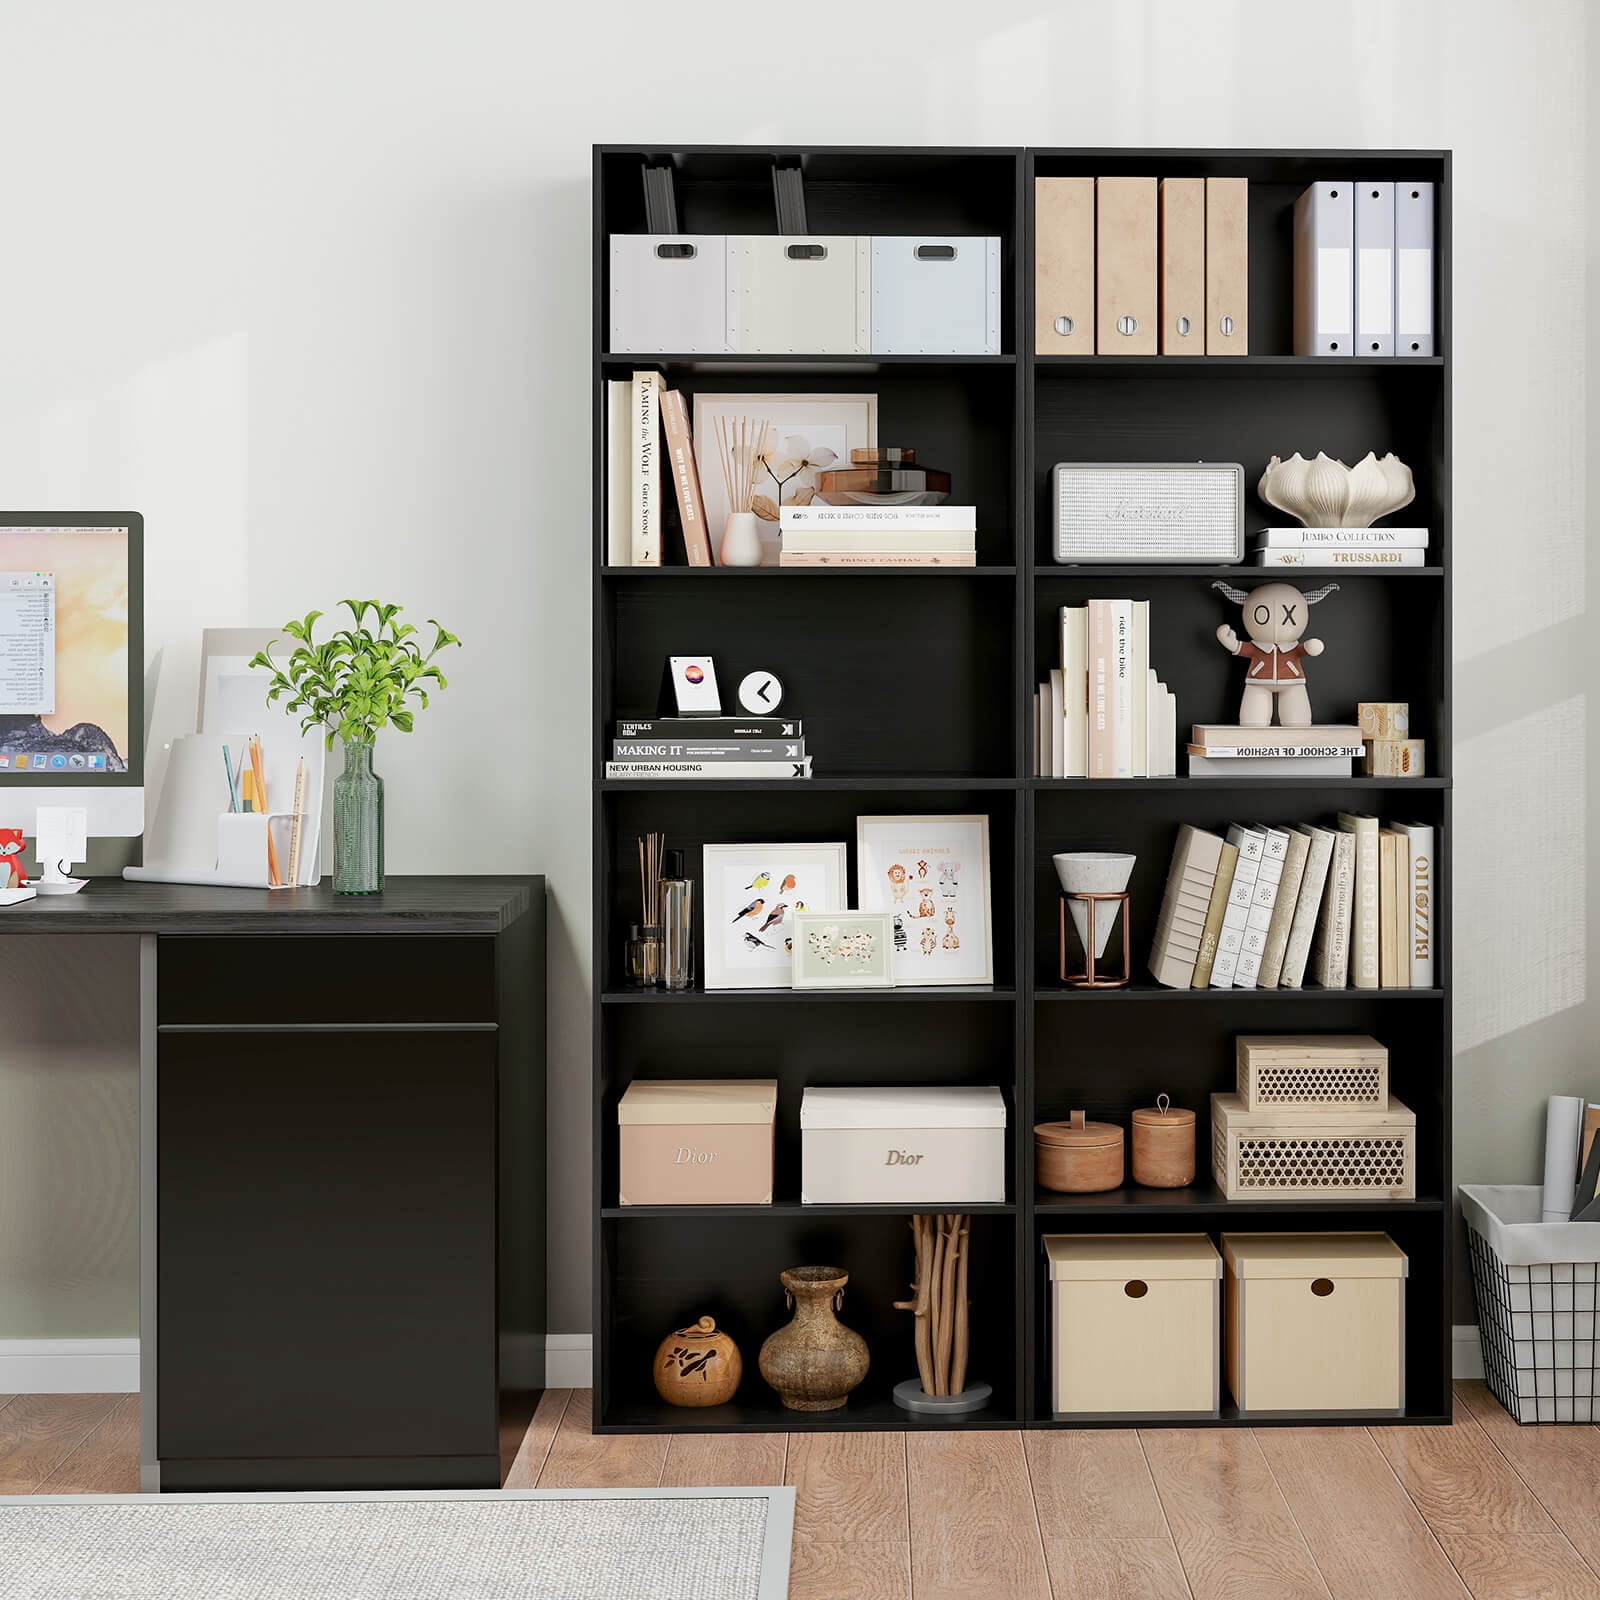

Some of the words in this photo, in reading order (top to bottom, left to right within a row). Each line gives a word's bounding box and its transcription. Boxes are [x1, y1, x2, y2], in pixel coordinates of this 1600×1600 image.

[641, 377, 652, 425] TAMING
[641, 428, 649, 441] the
[641, 442, 652, 476] WOLF
[641, 483, 650, 509] GREG
[641, 510, 650, 536] STONE
[1301, 530, 1334, 543] JUMBO
[1336, 530, 1396, 543] COLLECTION
[1332, 552, 1403, 563] TRUSSARDI
[616, 745, 667, 756] MAKING
[669, 745, 683, 756] IT
[609, 764, 630, 772] NEW
[631, 764, 662, 772] URBAN
[662, 764, 702, 772] HOUSING
[674, 1147, 718, 1165] Dior
[885, 1150, 924, 1166] Dior
